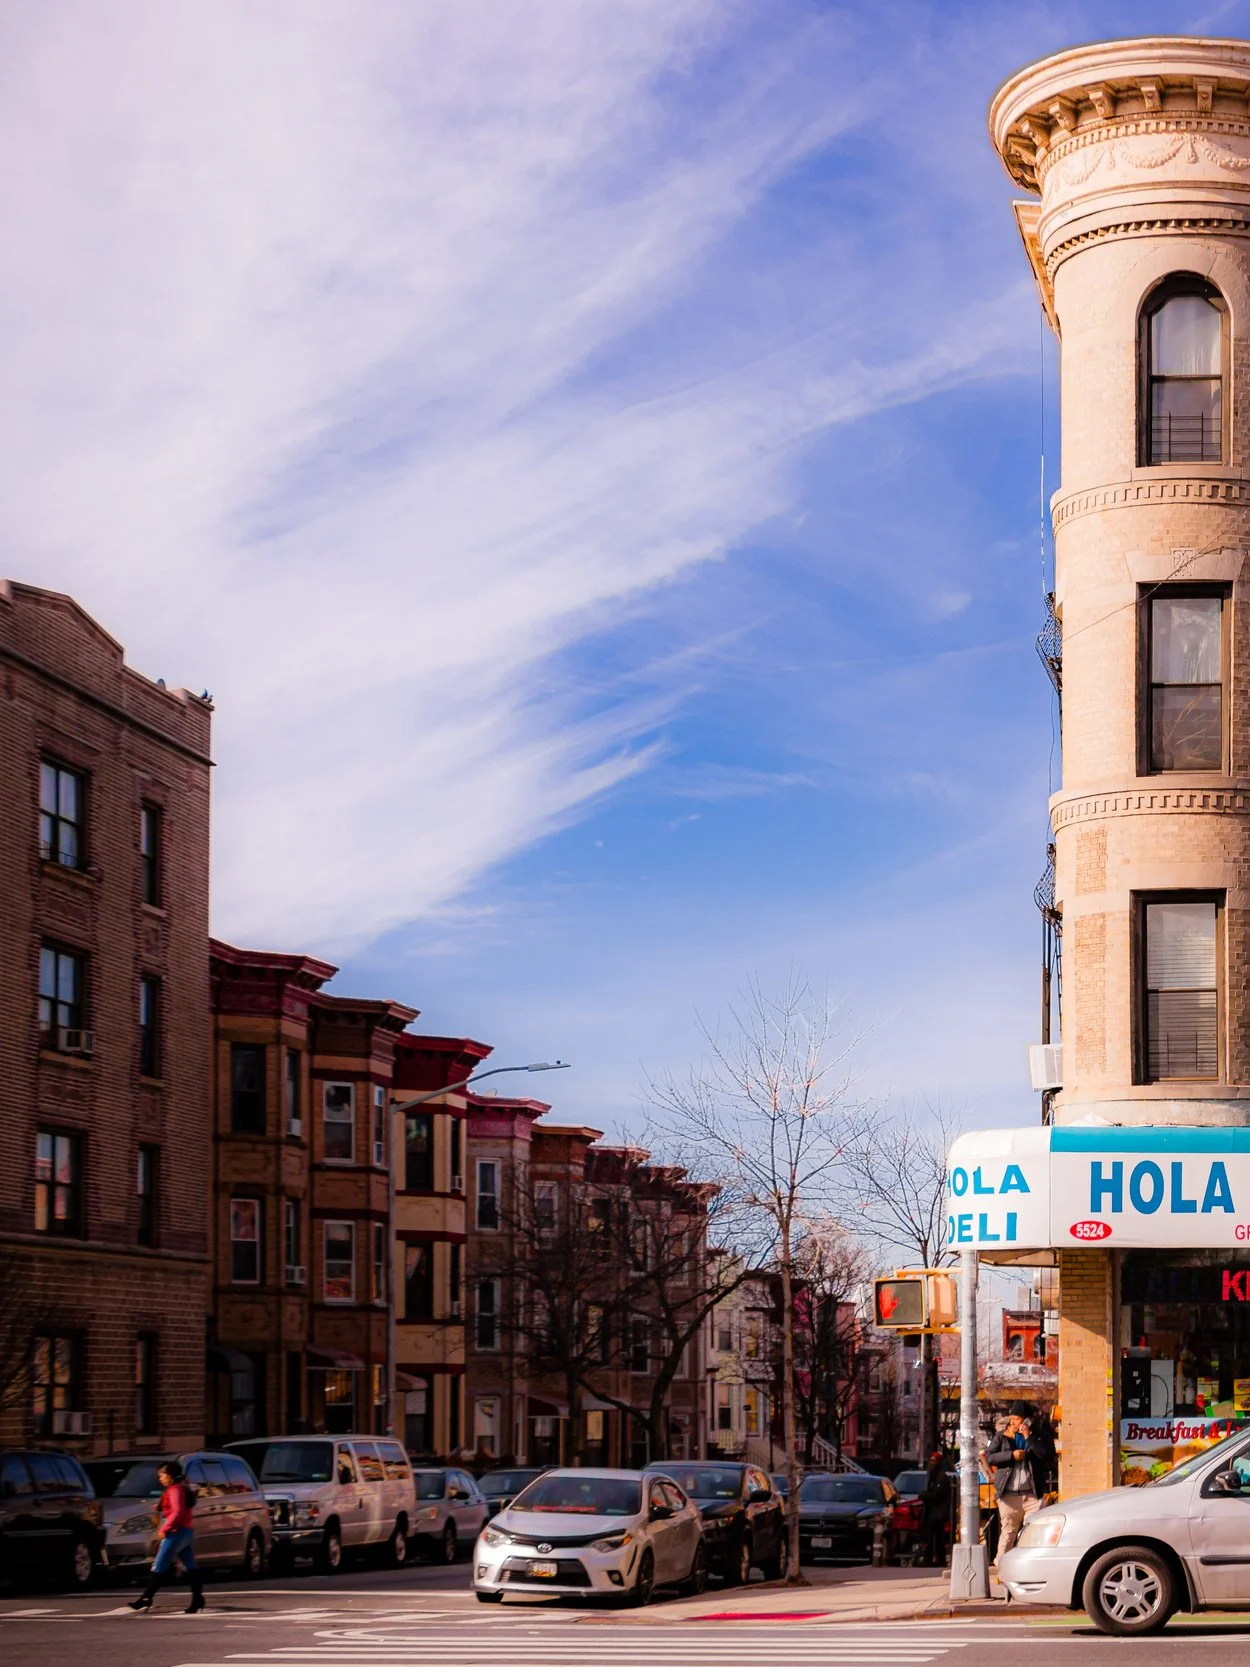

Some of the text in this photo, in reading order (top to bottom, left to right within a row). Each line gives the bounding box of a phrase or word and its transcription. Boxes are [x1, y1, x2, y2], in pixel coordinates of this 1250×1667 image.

[947, 1164, 1031, 1198] OLA
[1089, 1159, 1235, 1215] HOLA
[1075, 1223, 1105, 1239] 5524
[1126, 1421, 1206, 1444] Breakfast
[1208, 1421, 1222, 1439] &
